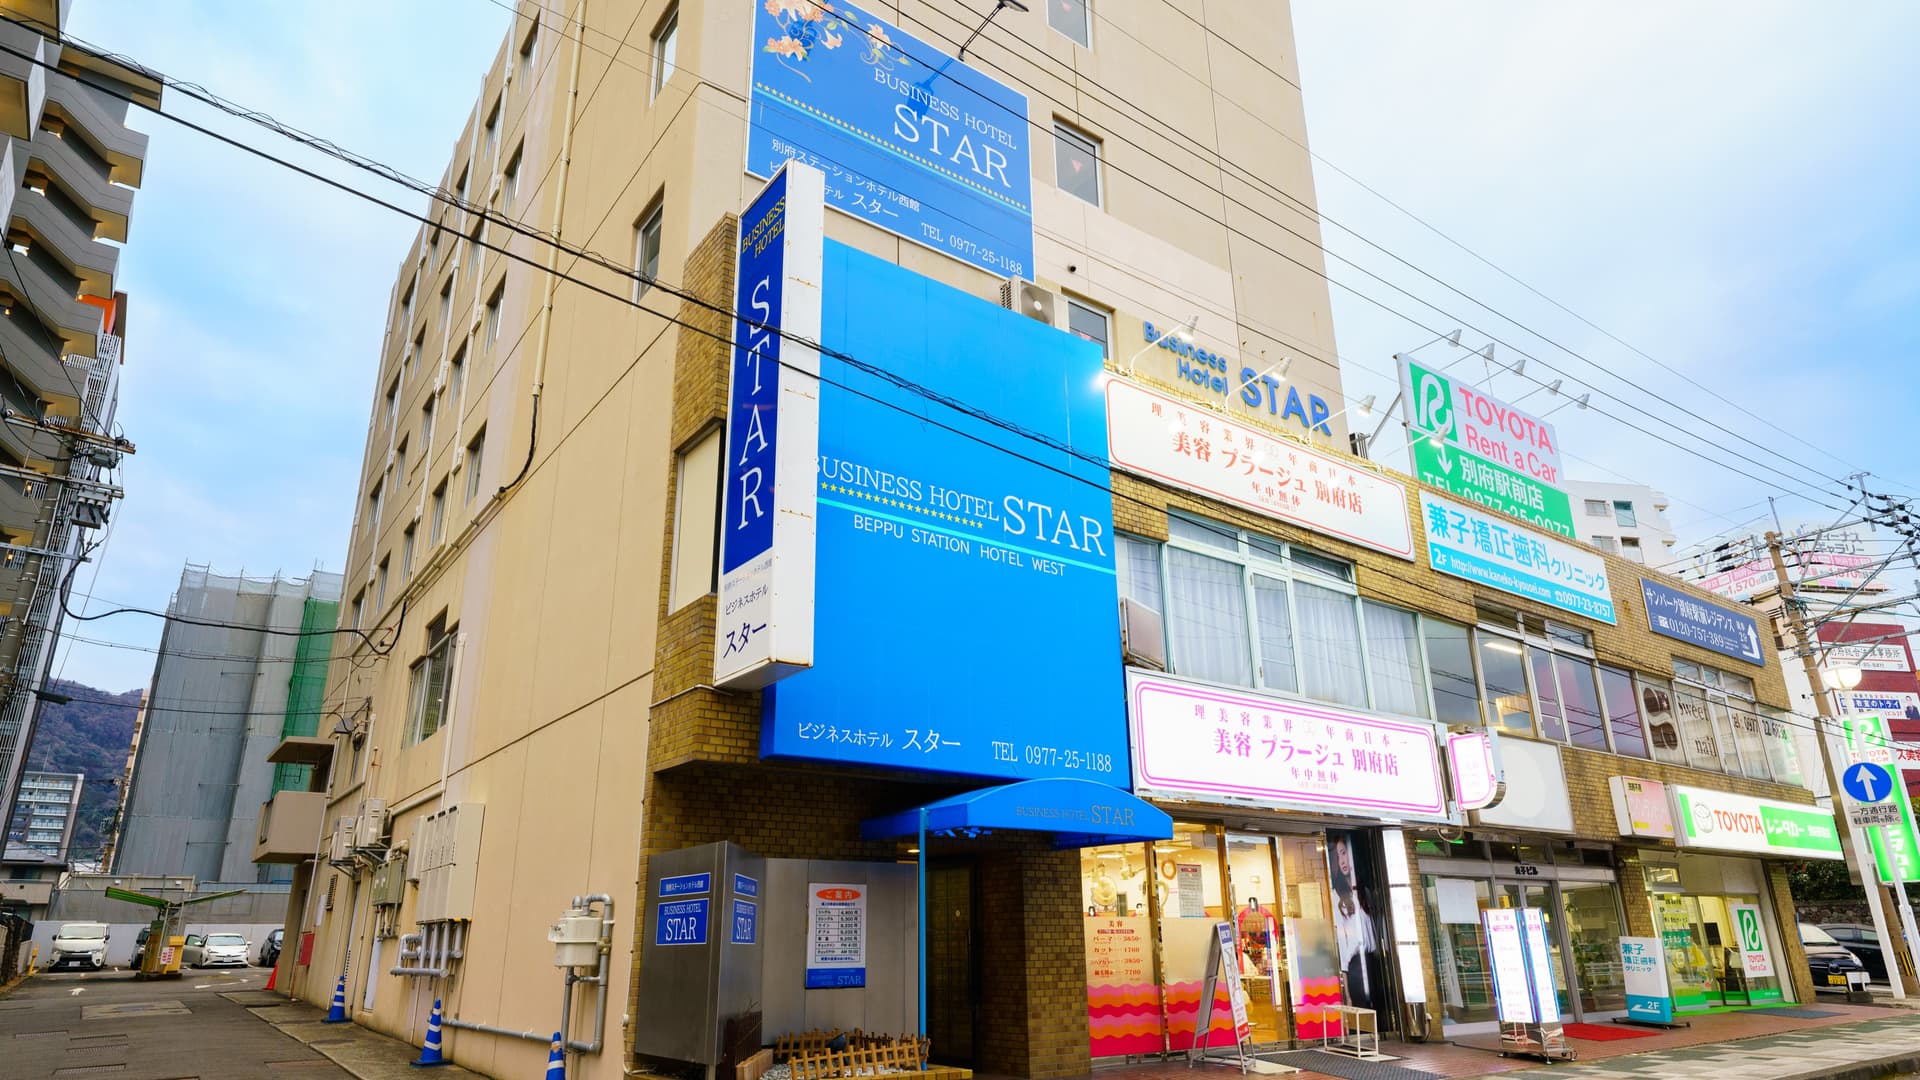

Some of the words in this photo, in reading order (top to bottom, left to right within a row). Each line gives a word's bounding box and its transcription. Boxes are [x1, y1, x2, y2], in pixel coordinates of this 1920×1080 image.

[873, 67, 960, 121] BUSINESS
[964, 112, 1017, 150] HOTEL
[893, 103, 1012, 188] STAR
[771, 138, 920, 213] 別府ステーションホテル西館
[851, 192, 899, 218] スター
[742, 195, 785, 254] BUSINESS
[754, 217, 785, 259] HOTEL
[920, 221, 944, 243] TEL
[949, 234, 1023, 276] 0977-25-1188
[1143, 320, 1227, 373] Business
[1176, 357, 1229, 396] Hotel
[737, 274, 770, 531] STAR
[1239, 366, 1332, 437] STAR
[1458, 386, 1555, 455] TOYOTA
[1465, 423, 1510, 467] Rent
[1513, 450, 1525, 471] a
[1526, 450, 1557, 484] Car
[816, 455, 923, 502] USINESS
[929, 484, 1000, 523] HOTEL
[1172, 430, 1212, 463] 美容
[1221, 449, 1307, 493] プラージュ
[1314, 478, 1363, 515] 別府店
[1458, 454, 1545, 513] 別府駅前店
[1251, 480, 1301, 507] 年中無休
[1002, 494, 1107, 557] STAR
[853, 514, 904, 539] BEPPU
[911, 528, 971, 555] STATION
[980, 544, 1024, 568] HOTEL
[1031, 556, 1066, 577] WEST
[1426, 502, 1605, 591] 兼子矯正歯科クリニック
[1434, 547, 1447, 566] 2F
[725, 583, 769, 616] ビジネスホテル
[723, 622, 768, 659] スター
[1668, 617, 1725, 648] 0120-757-389
[798, 722, 893, 749] ビジネスホテル
[902, 727, 961, 753] スター
[1215, 727, 1252, 758] 美容
[1261, 734, 1345, 766] プラージュ
[1352, 748, 1399, 776] 別府店
[992, 740, 1018, 762] TEL
[1025, 744, 1113, 773] 0977-25-1188
[1291, 766, 1339, 784] 年中無休
[1015, 806, 1059, 818] BUSINESS
[1091, 804, 1135, 826] STAR
[1713, 809, 1765, 835] TOYOTA
[1765, 818, 1806, 837] レンタカー
[1850, 804, 1899, 816] 一方通行路
[664, 904, 686, 915] BUSINESS
[686, 903, 702, 913] HOTEL
[665, 917, 697, 941] STAR
[735, 917, 752, 940] STAR
[1622, 943, 1645, 955] 兼子
[837, 975, 862, 985] STAR
[1625, 965, 1652, 973] クリニック
[1647, 1000, 1660, 1010] 2F
